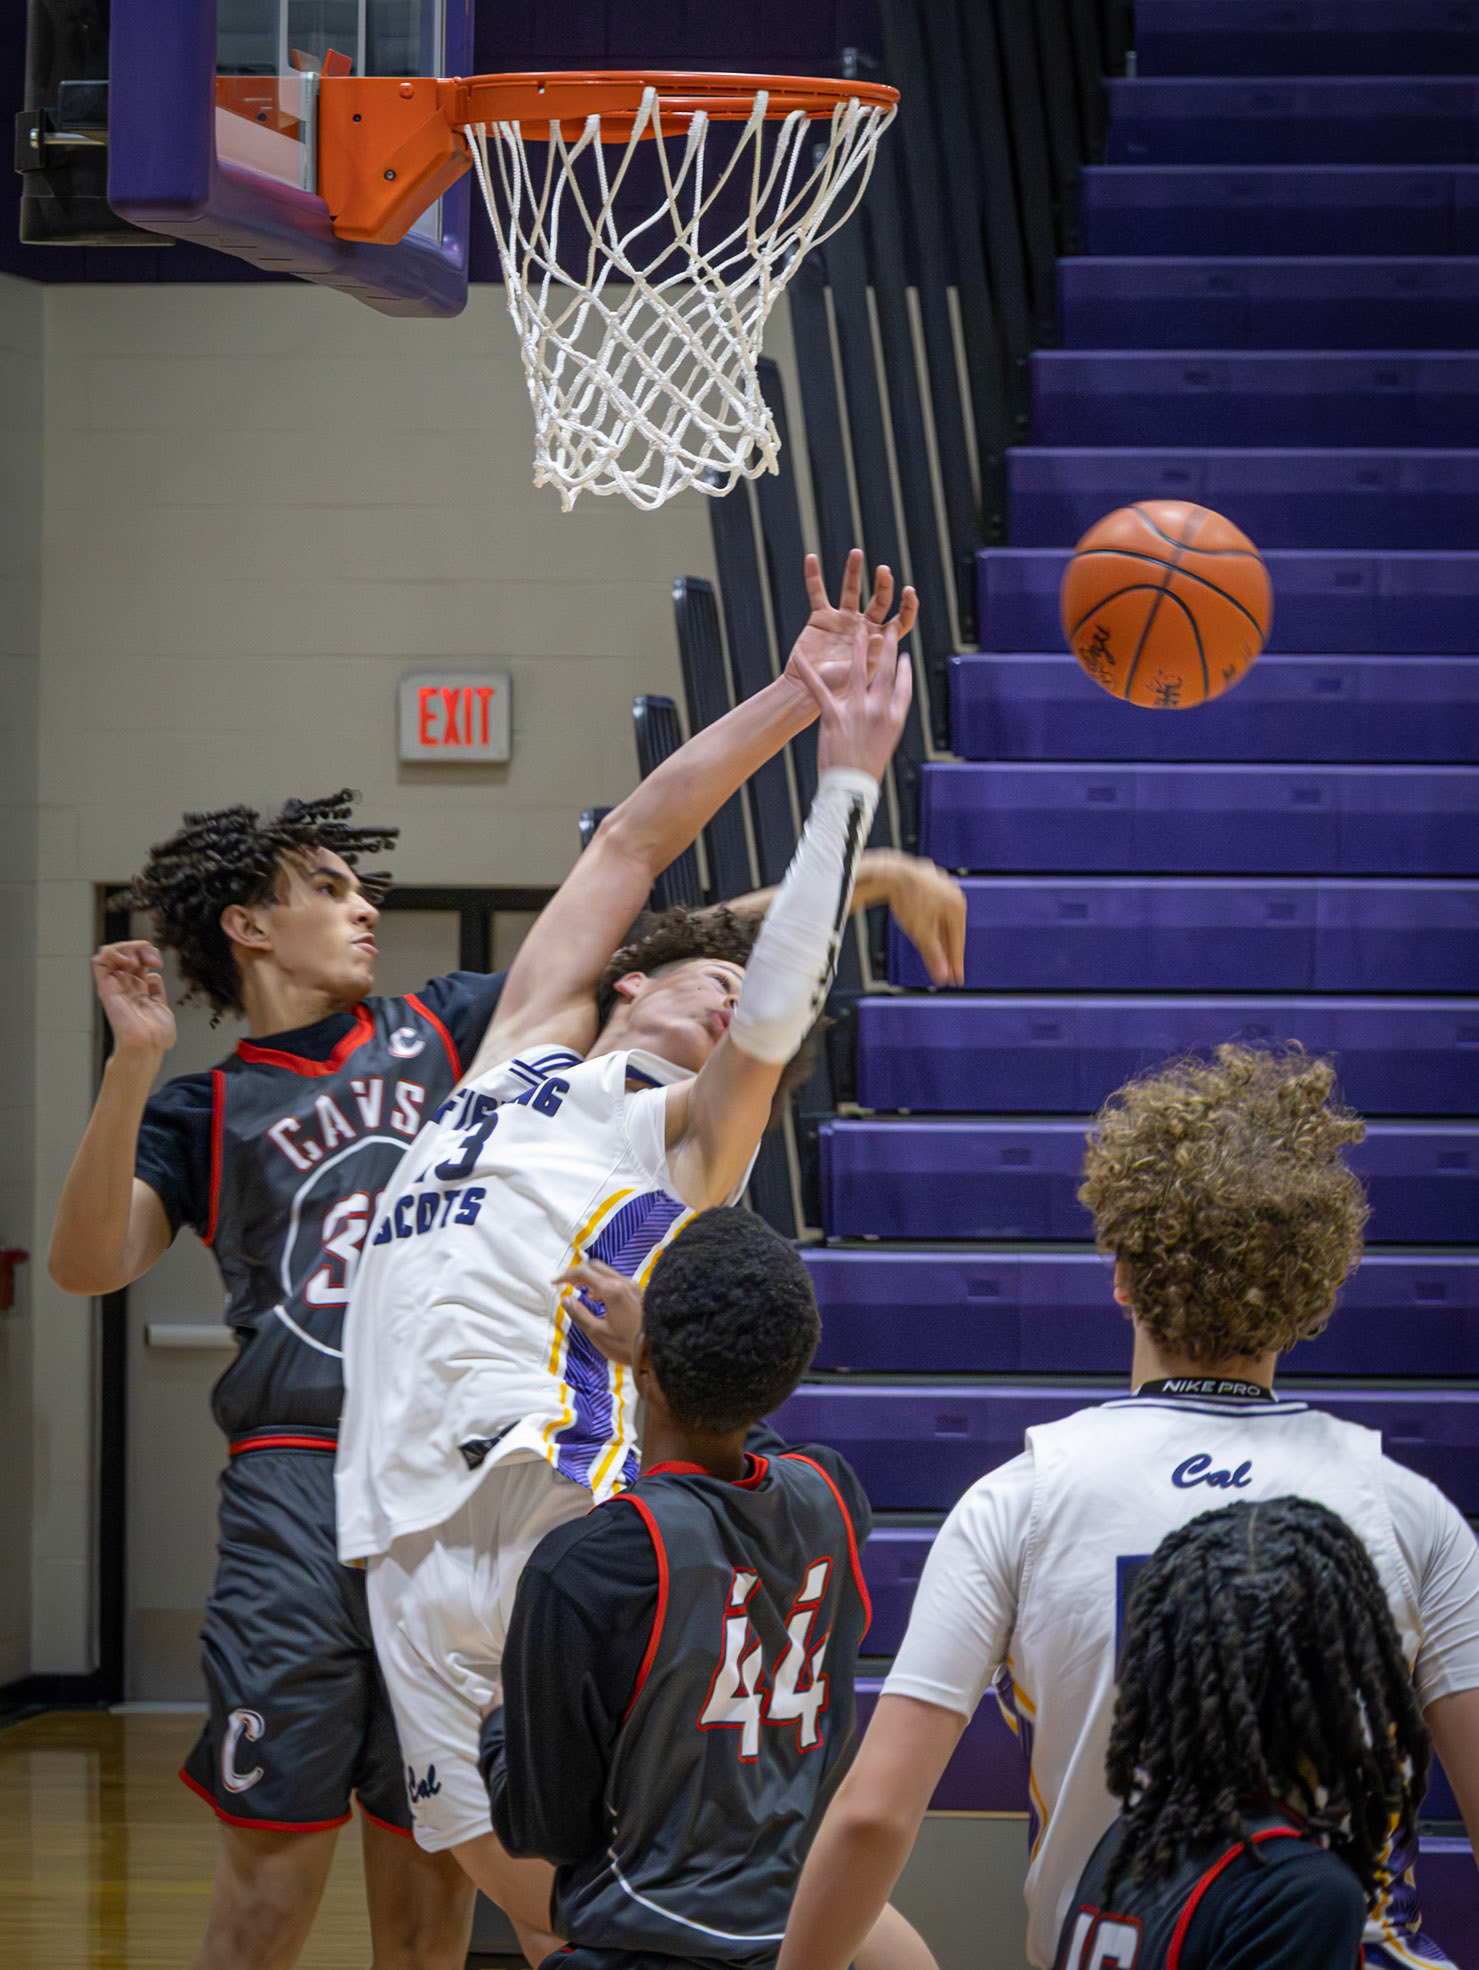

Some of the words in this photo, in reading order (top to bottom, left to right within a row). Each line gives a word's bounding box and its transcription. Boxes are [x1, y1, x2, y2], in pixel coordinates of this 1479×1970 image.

[418, 686, 495, 746] EXIT
[267, 1076, 426, 1172] CAVS
[413, 1112, 498, 1184] 3
[1162, 1379, 1216, 1393] NIKE
[1217, 1381, 1261, 1396] PRO
[1171, 1453, 1253, 1490] Cal
[697, 1556, 833, 1763] 44
[220, 1707, 267, 1793] C
